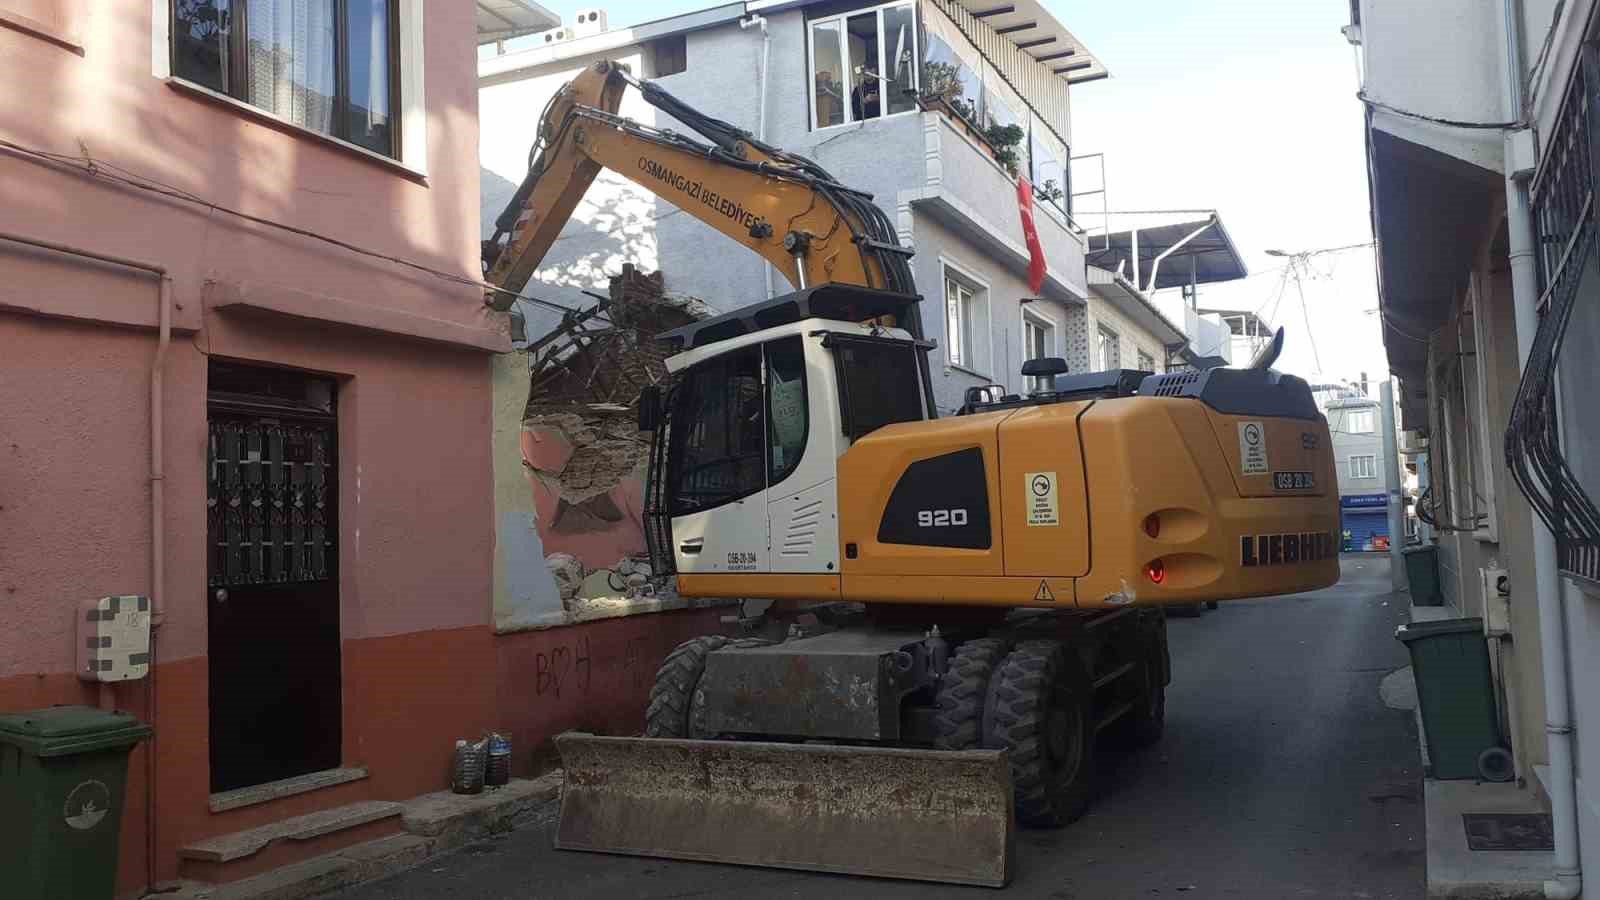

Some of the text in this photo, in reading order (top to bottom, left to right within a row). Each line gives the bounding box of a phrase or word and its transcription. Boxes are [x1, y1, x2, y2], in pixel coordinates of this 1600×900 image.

[637, 155, 766, 230] OSMANGAZİ BELEDİYES
[918, 508, 968, 527] 920
